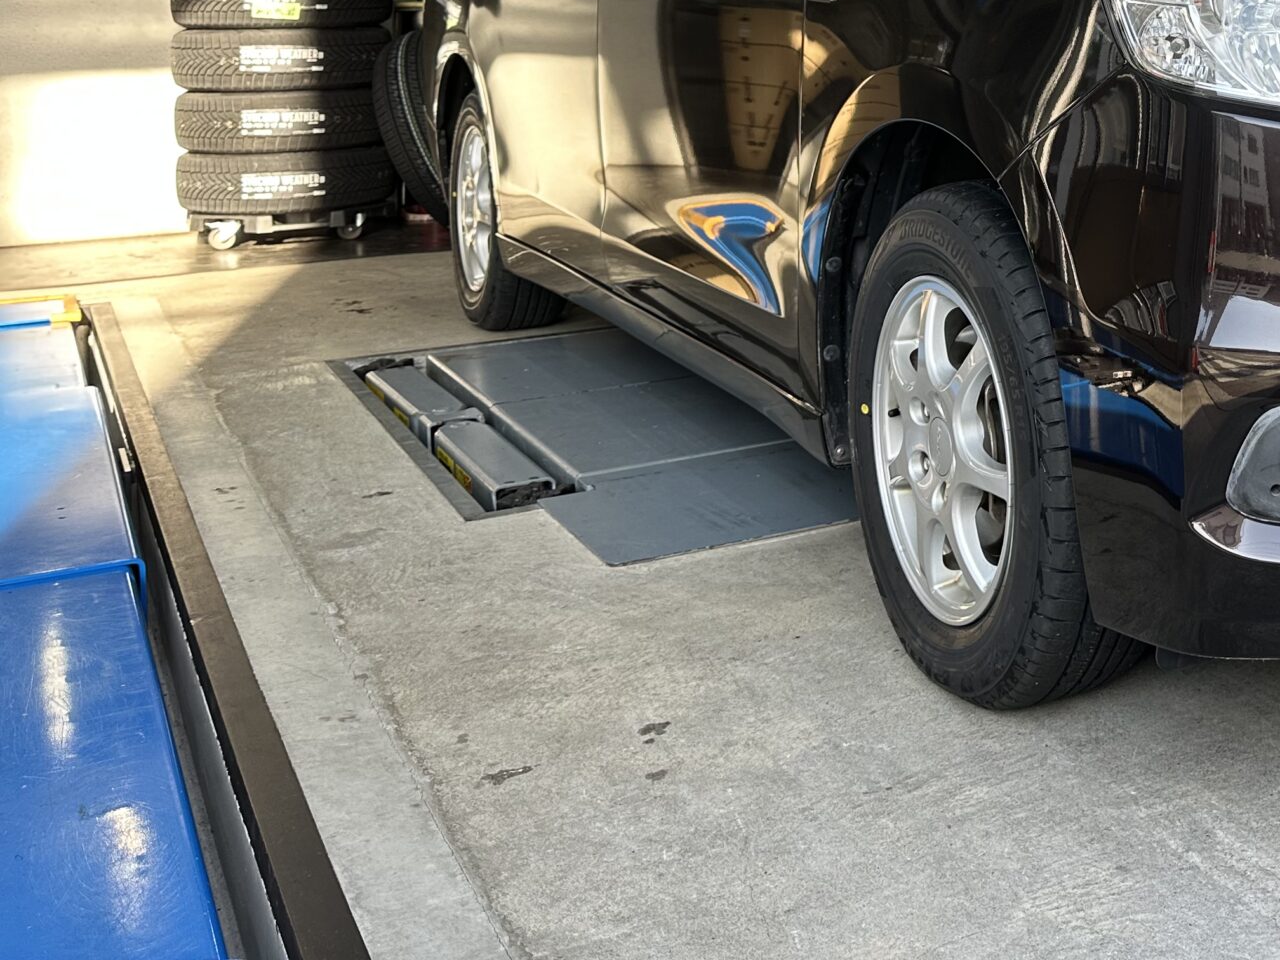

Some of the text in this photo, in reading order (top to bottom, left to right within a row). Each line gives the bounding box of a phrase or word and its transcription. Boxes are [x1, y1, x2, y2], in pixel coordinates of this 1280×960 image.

[279, 48, 318, 59] WEATHER
[280, 111, 320, 123] WEATHER
[280, 174, 320, 186] WEATHER
[899, 218, 975, 279] BRIDGESTONE
